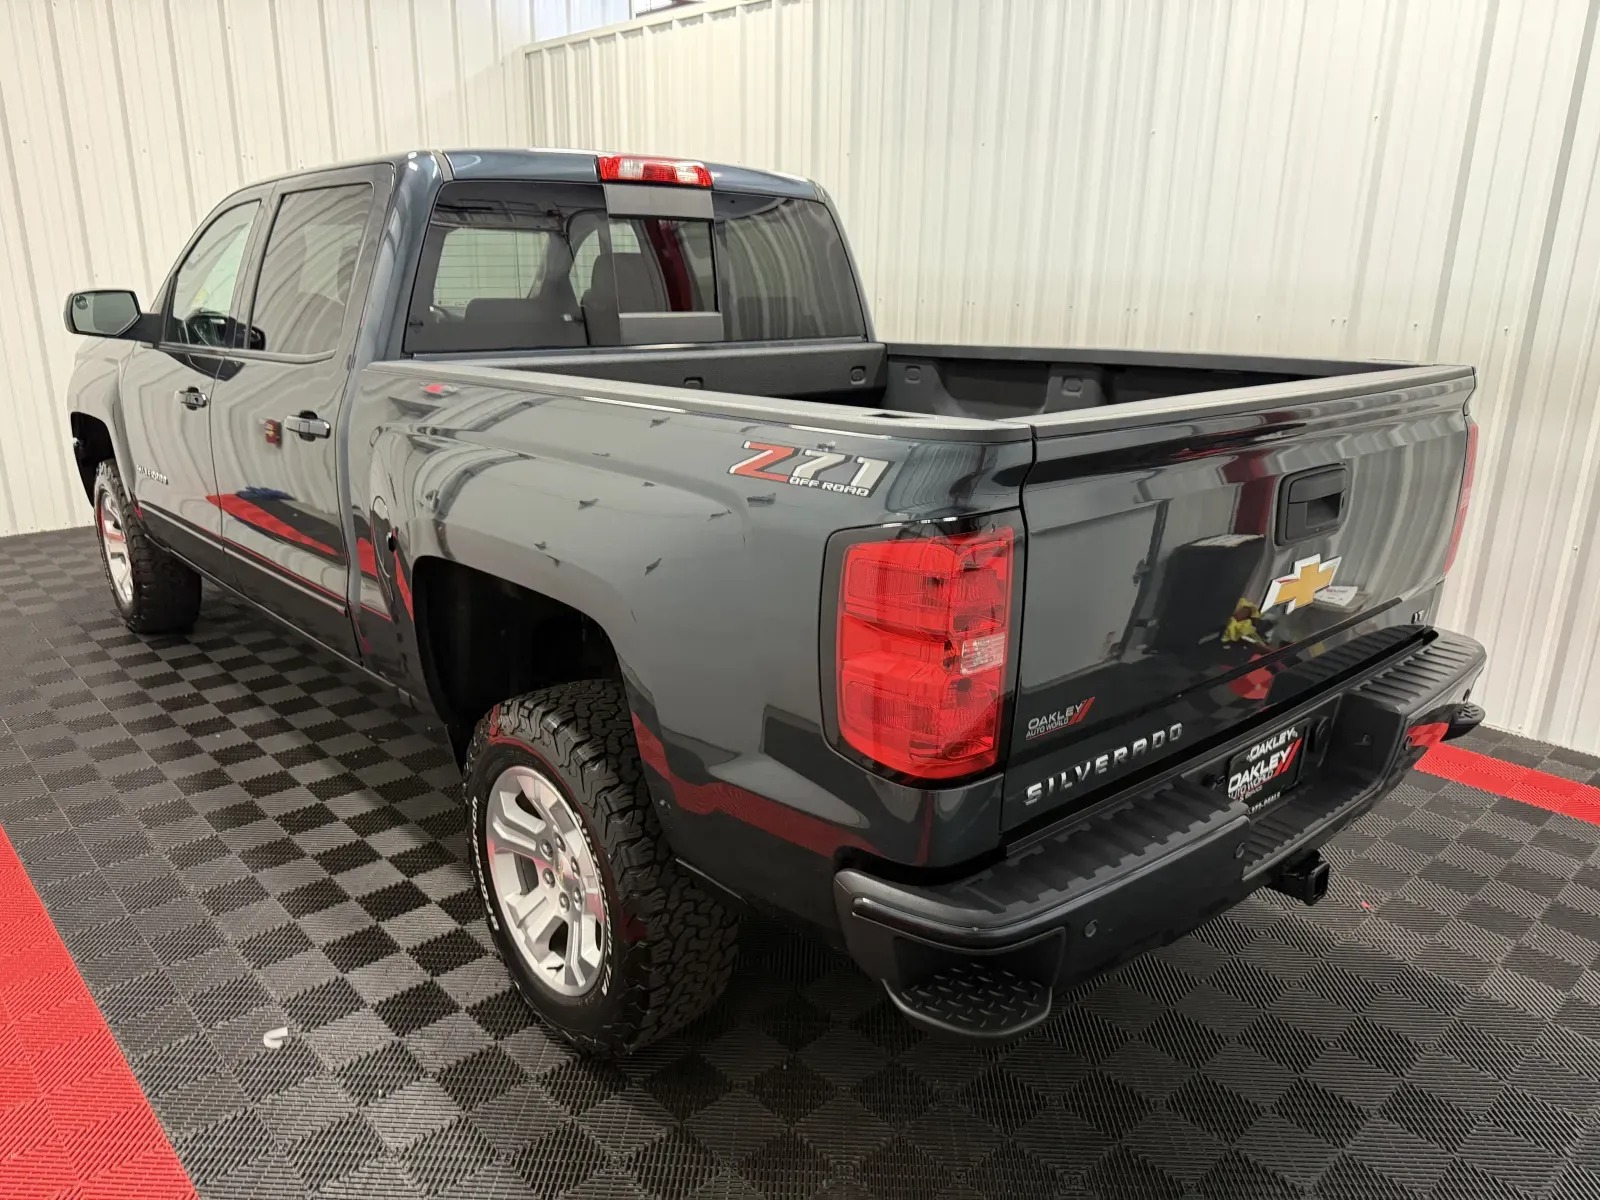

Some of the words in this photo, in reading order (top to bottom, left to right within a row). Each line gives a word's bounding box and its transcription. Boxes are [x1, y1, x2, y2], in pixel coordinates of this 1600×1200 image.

[727, 440, 894, 490] Z71
[789, 476, 819, 488] OFF
[822, 482, 870, 497] ROAD
[1026, 725, 1045, 738] AUTO
[1046, 718, 1069, 733] WORLD
[1028, 701, 1086, 730] OAKLEY
[1249, 727, 1295, 760] OAKLEY
[1024, 722, 1183, 806] SILVERADO
[1228, 746, 1291, 793] OAKLEY
